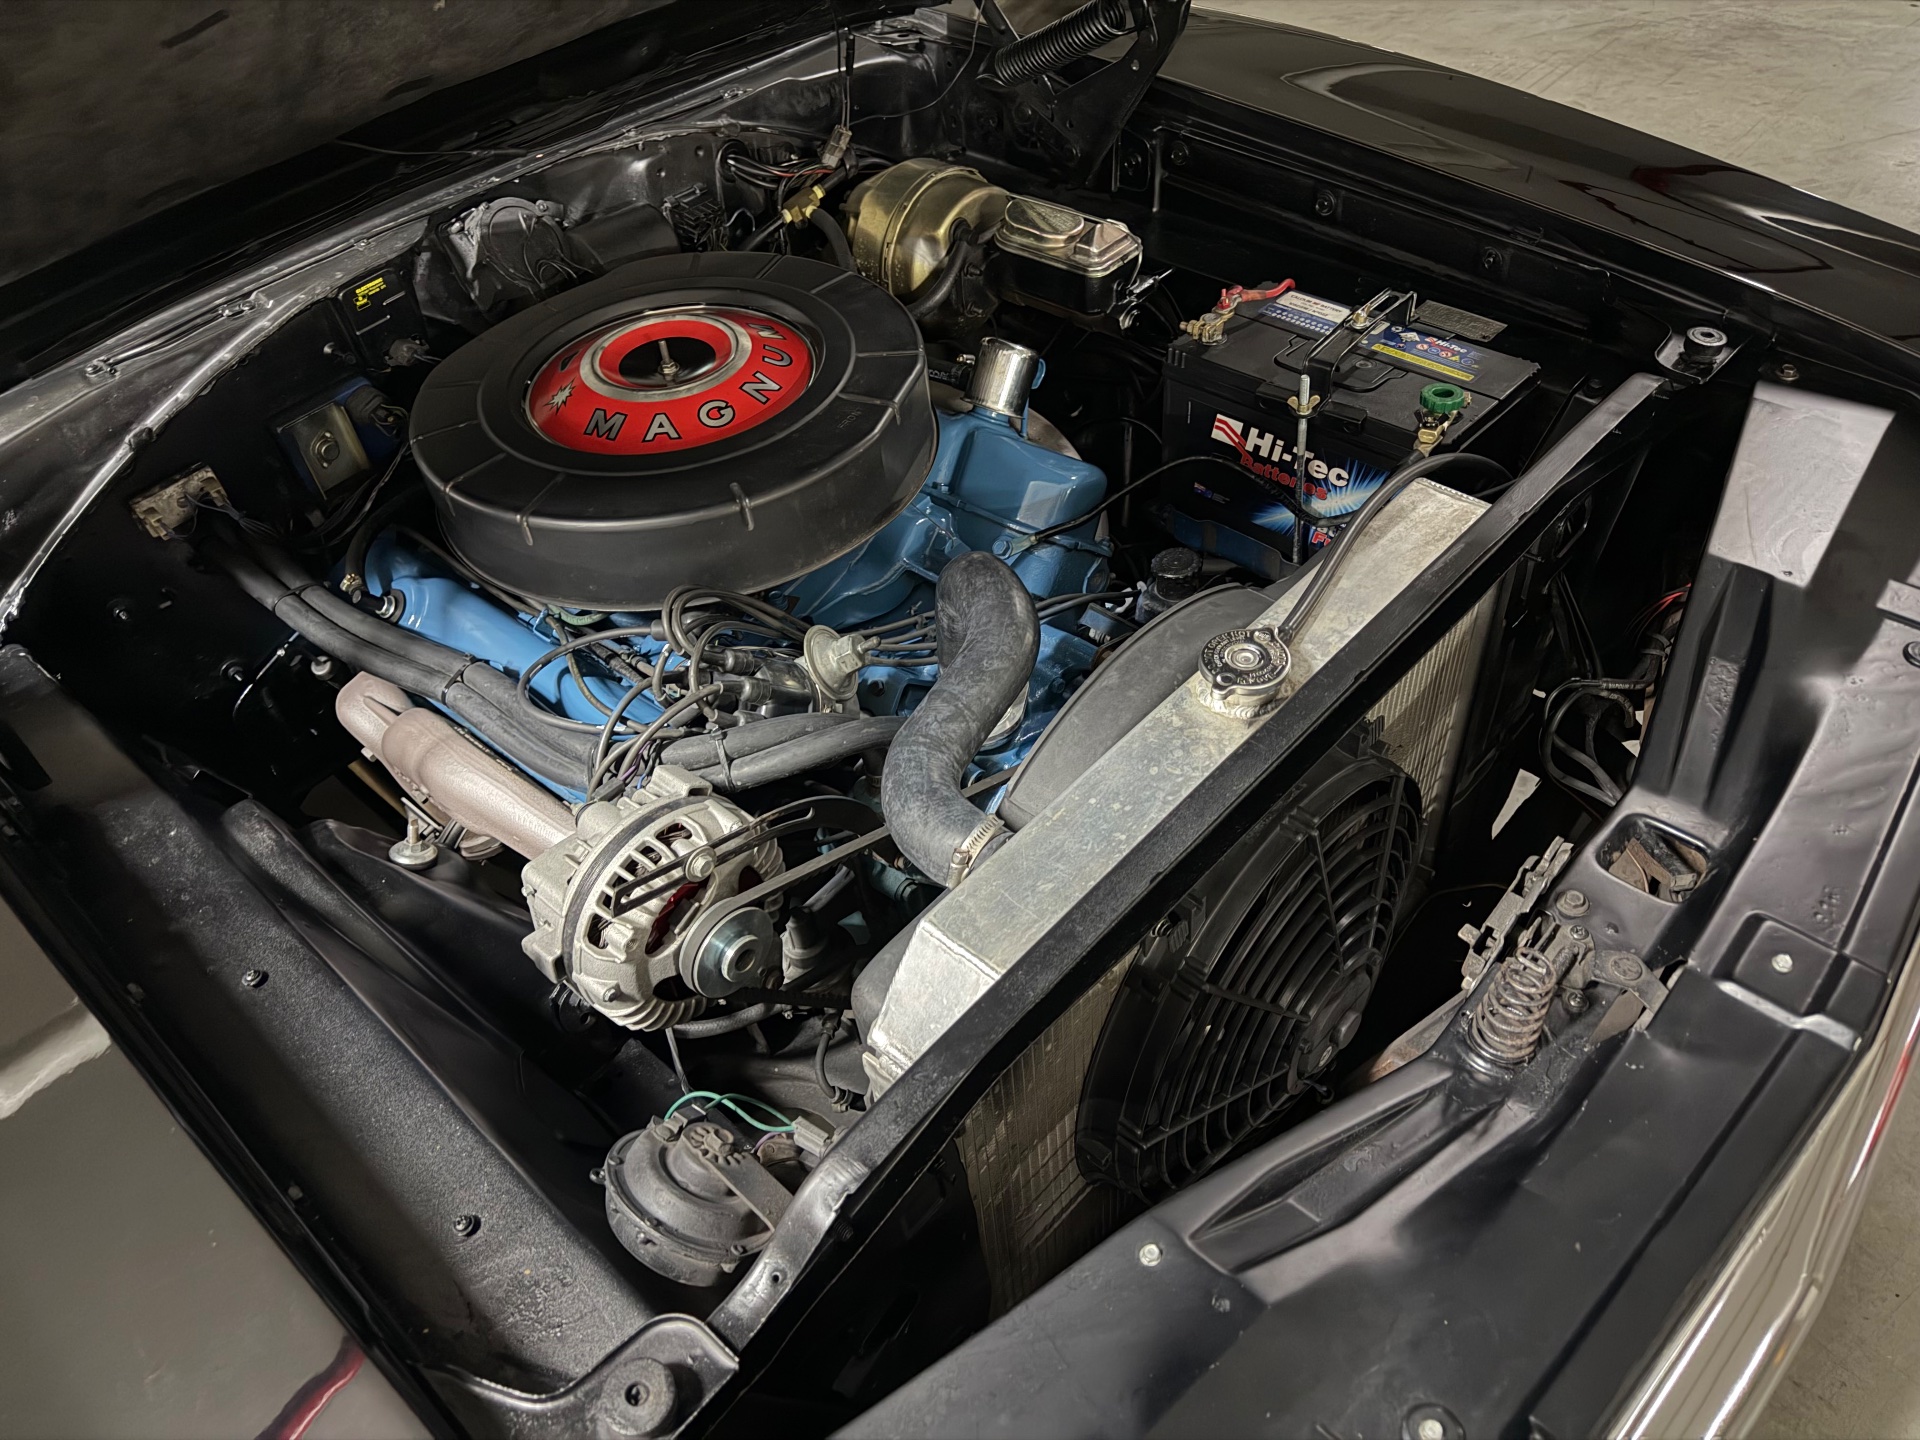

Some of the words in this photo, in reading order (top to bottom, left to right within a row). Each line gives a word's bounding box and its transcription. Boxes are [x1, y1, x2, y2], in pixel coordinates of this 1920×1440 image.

[583, 322, 793, 443] MAGNUM
[1240, 453, 1328, 500] Batteres
[1245, 426, 1349, 487] Hi-Tec
